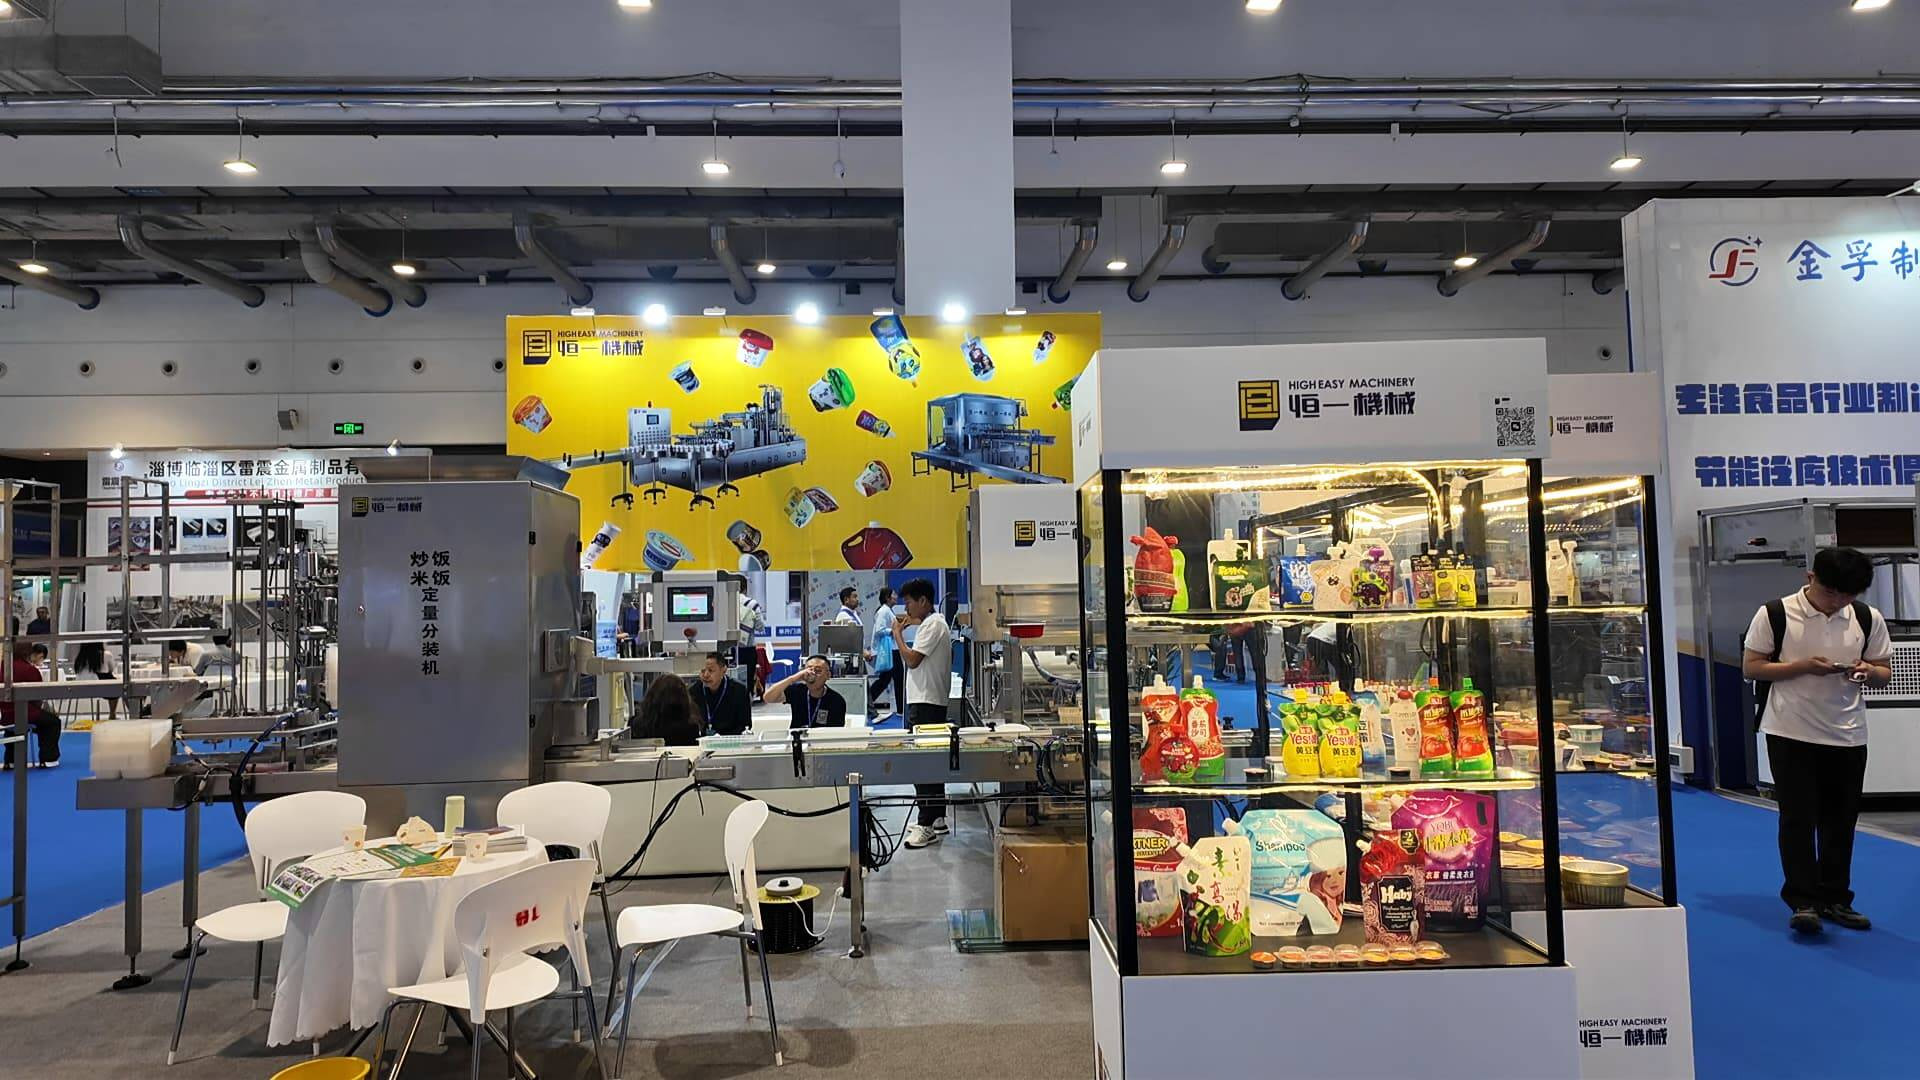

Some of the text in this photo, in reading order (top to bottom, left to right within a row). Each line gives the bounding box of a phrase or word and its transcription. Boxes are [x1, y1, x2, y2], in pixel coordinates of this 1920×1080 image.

[1349, 377, 1415, 388] MACHINERY
[421, 587, 439, 675] 定量分装机
[1255, 841, 1305, 853] Shampoo
[1621, 1018, 1668, 1026] MACHINERY
